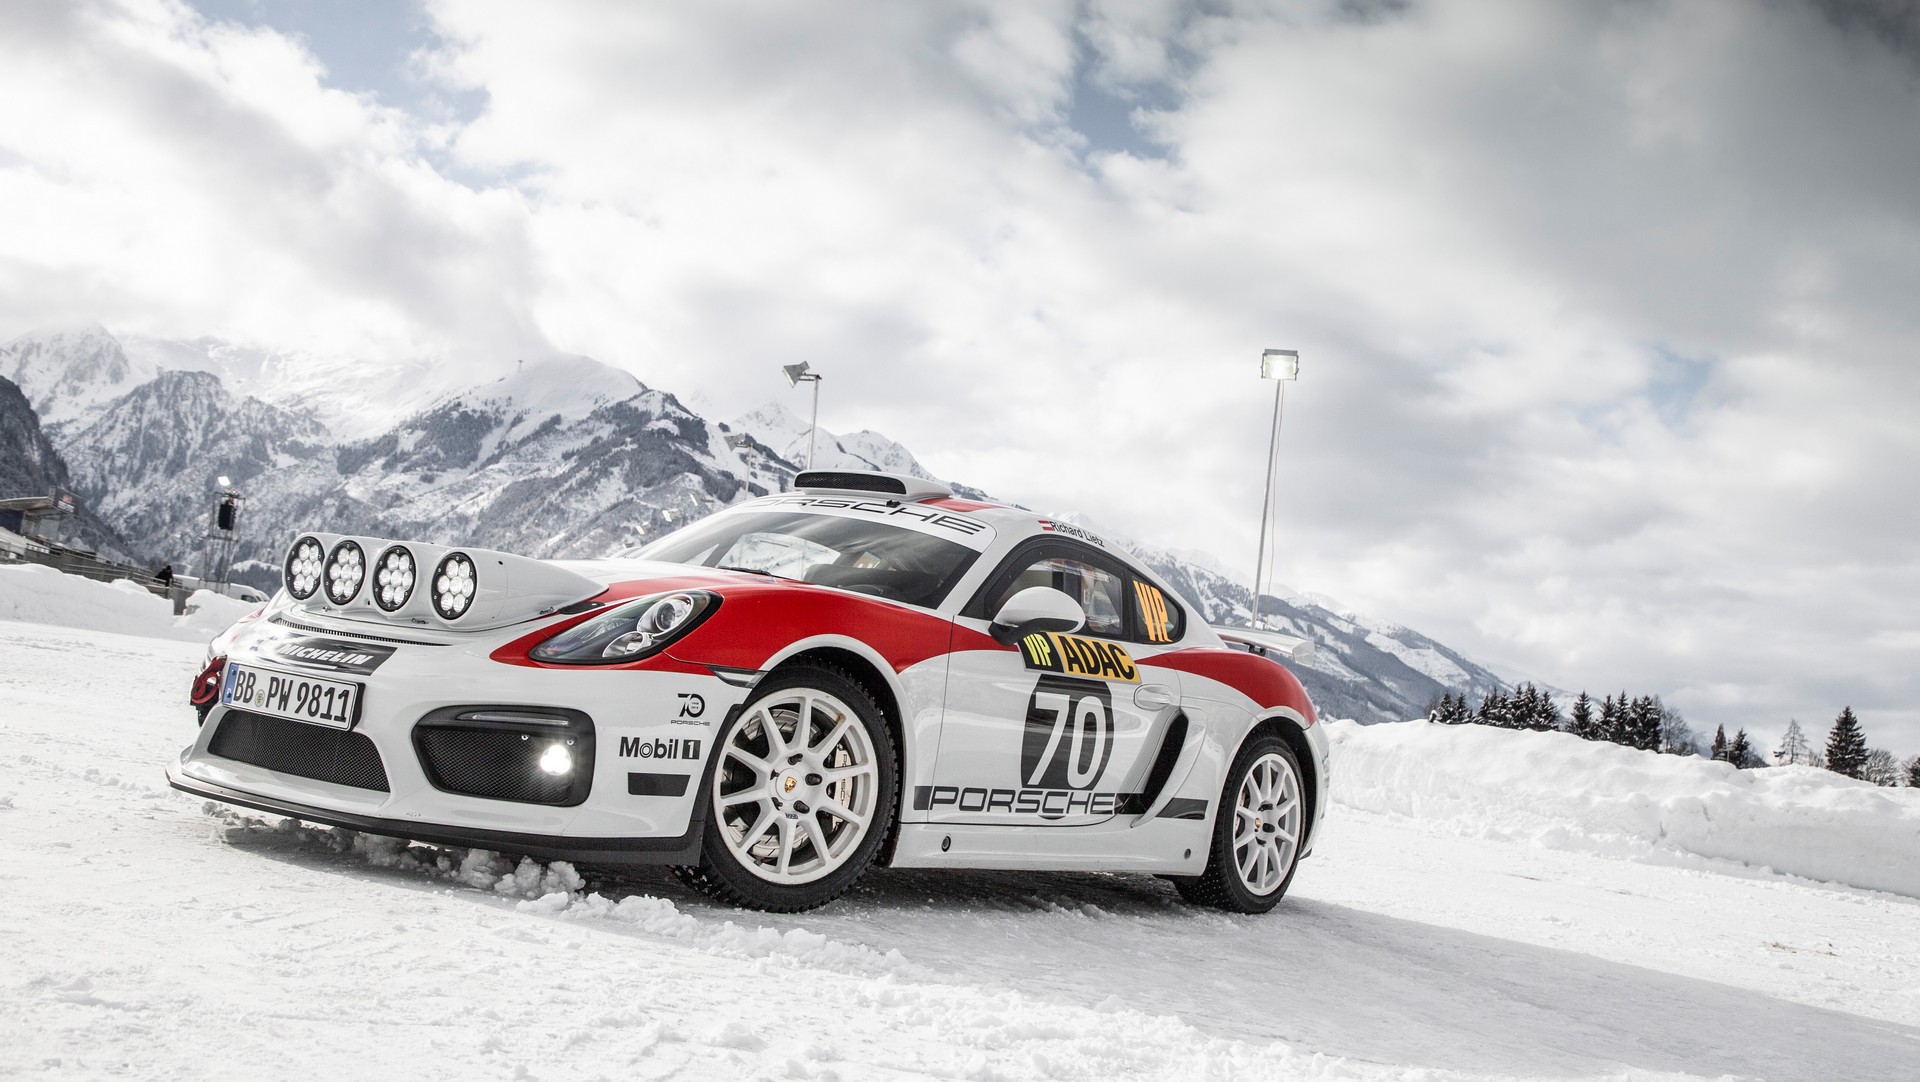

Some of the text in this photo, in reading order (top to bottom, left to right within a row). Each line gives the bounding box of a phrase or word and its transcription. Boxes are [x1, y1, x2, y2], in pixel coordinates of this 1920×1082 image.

[1049, 520, 1083, 538] Richard
[1133, 580, 1173, 642] VIP
[279, 643, 375, 665] MICHELIN
[1023, 633, 1135, 680] VIP ADAC
[233, 670, 350, 722] BB PW 9811
[677, 693, 705, 718] 70
[619, 736, 679, 759] Mobil
[1027, 691, 1106, 789] 70
[929, 786, 1115, 815] PORSCHE
